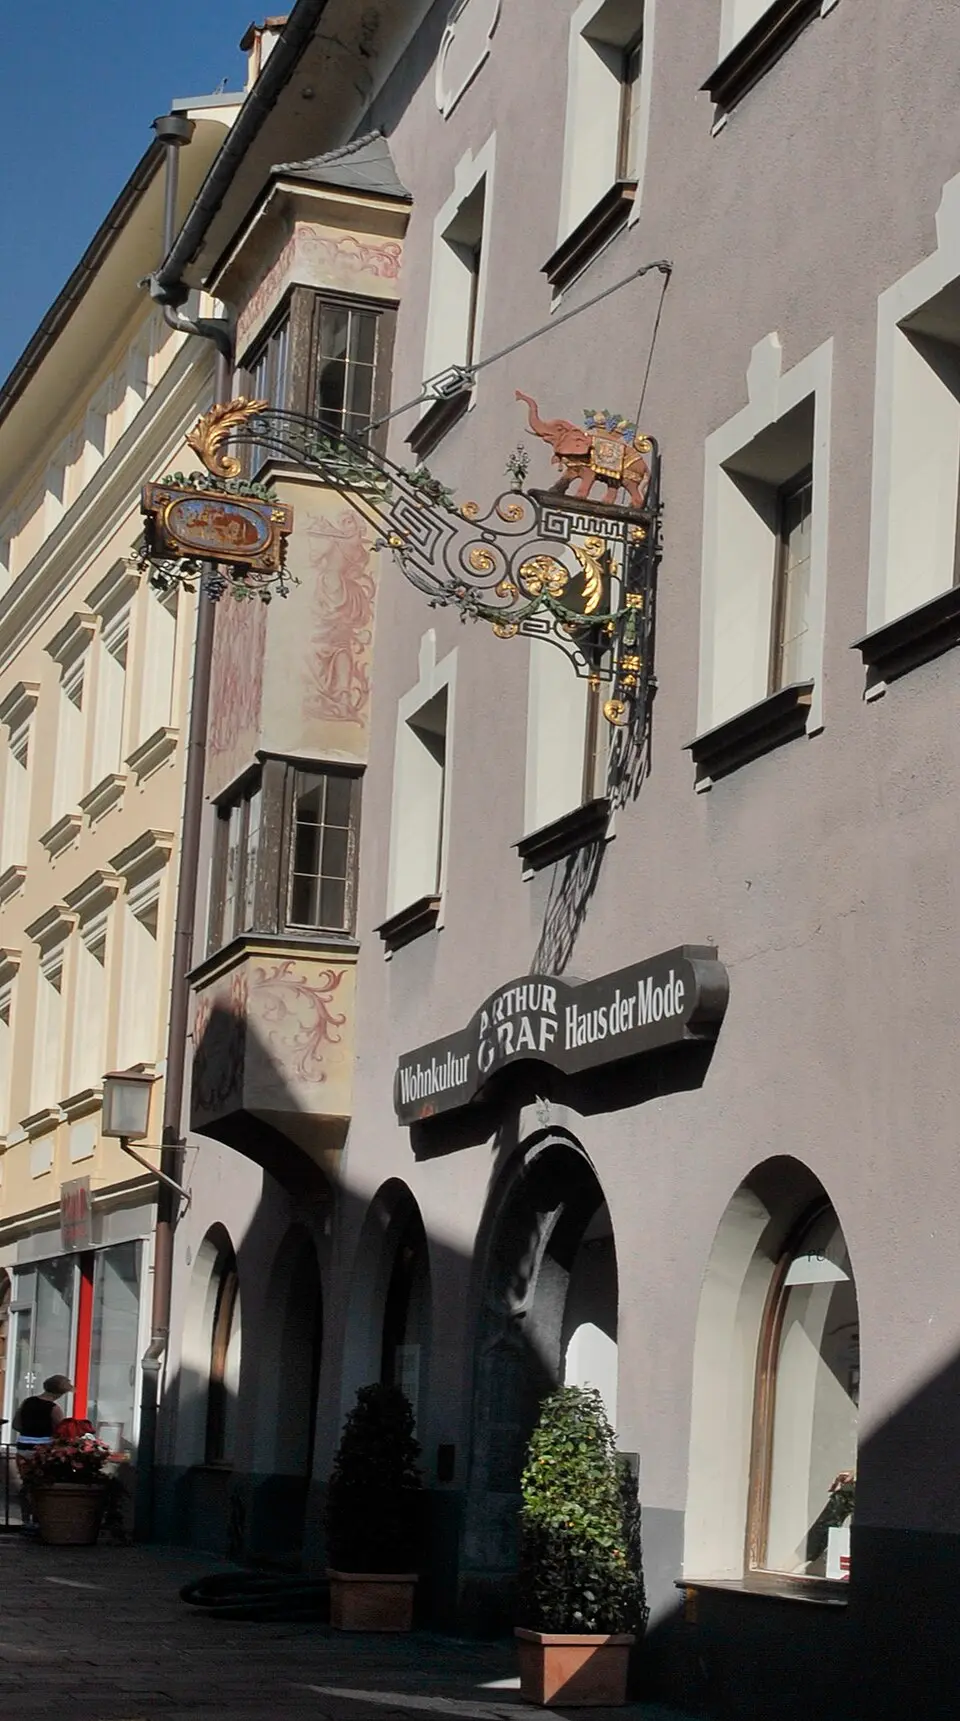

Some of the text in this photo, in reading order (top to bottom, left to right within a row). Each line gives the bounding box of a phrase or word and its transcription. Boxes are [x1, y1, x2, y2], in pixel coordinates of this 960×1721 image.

[478, 983, 557, 1040] ARTHUR
[565, 969, 685, 1051] Haus der Mode
[477, 1015, 558, 1073] GRAF
[400, 1051, 470, 1105] Wohnkultur
